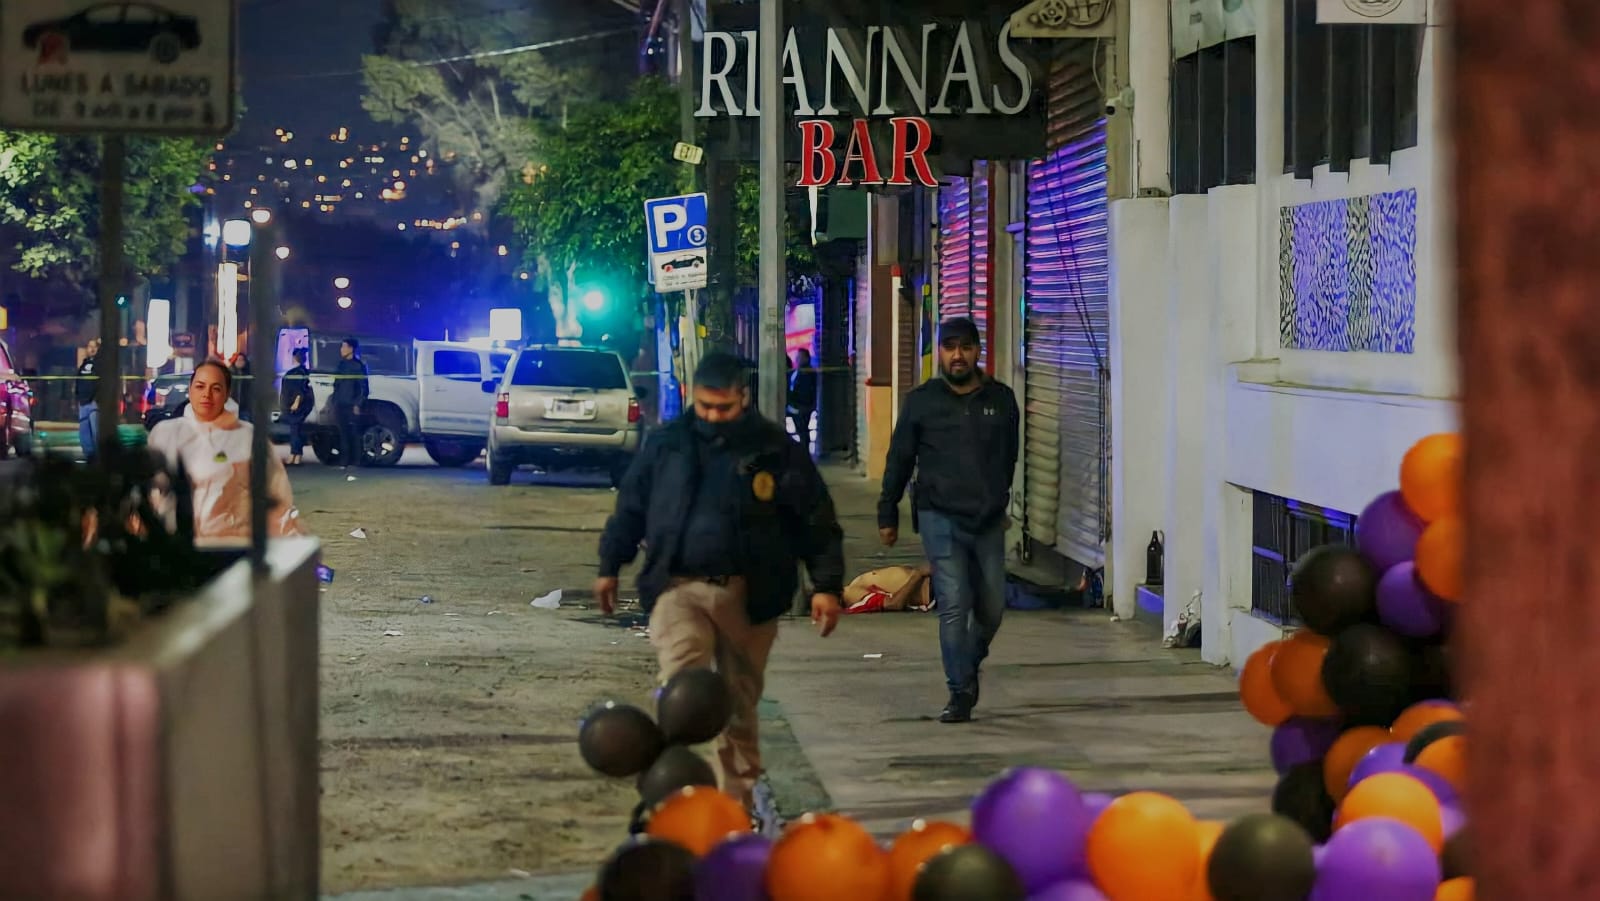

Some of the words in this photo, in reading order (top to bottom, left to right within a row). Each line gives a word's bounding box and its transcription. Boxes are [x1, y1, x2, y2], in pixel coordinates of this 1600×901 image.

[100, 72, 113, 94] A
[797, 116, 938, 188] BAR
[653, 203, 687, 248] P
